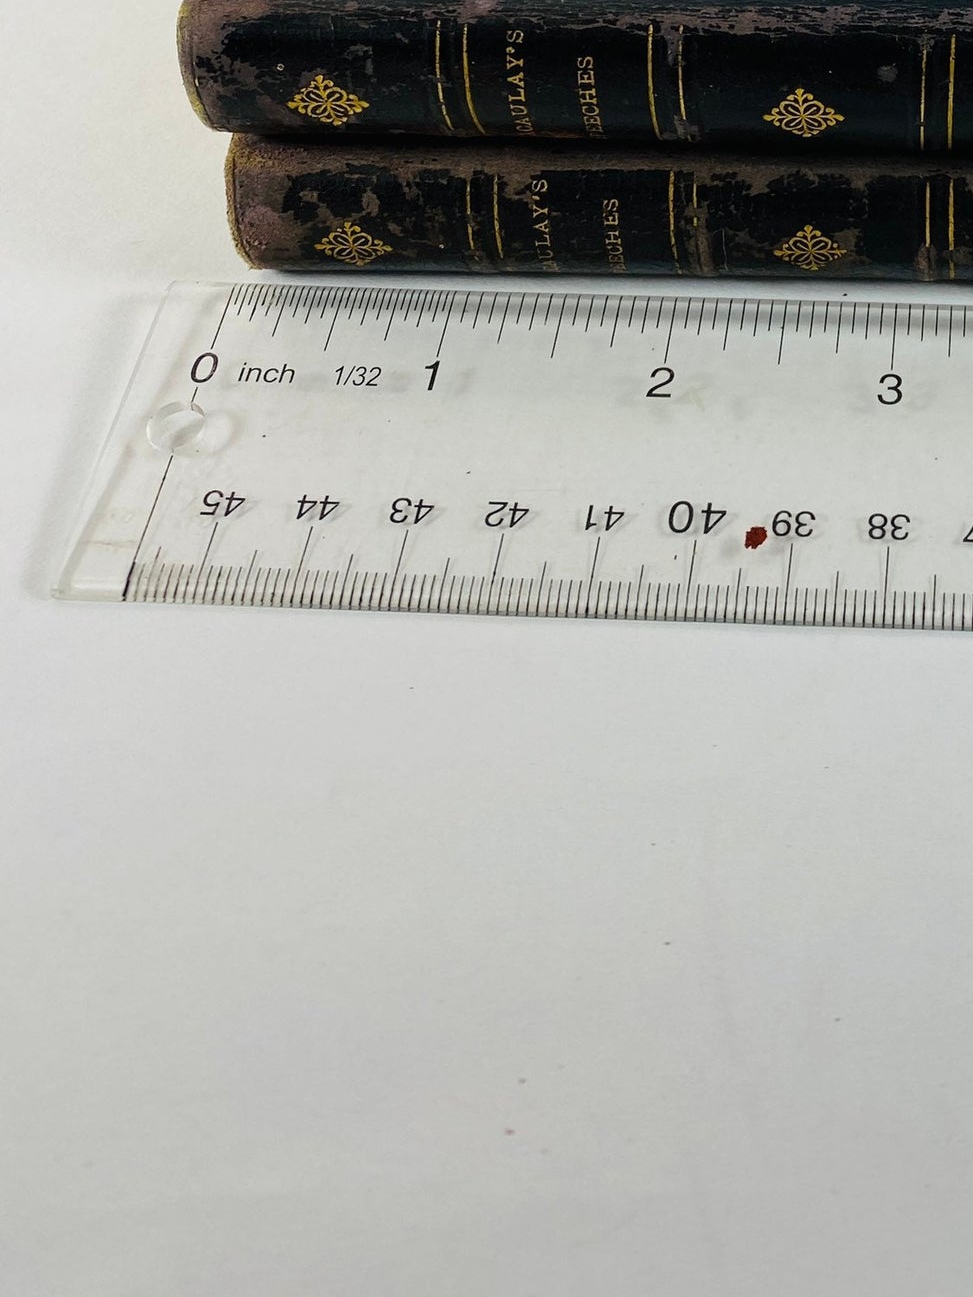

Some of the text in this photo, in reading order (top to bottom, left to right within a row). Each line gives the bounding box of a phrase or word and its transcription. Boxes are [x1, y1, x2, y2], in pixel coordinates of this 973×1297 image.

[506, 29, 536, 136] CAULAY'S
[190, 352, 219, 384] 0
[238, 363, 296, 384] inch
[334, 365, 382, 387] 1/32
[425, 360, 441, 391] 1
[646, 367, 674, 398] 2
[876, 373, 904, 405] 3
[199, 489, 247, 518] 45
[295, 493, 341, 521] 44
[389, 497, 436, 524] 43
[484, 501, 530, 528] 42
[584, 504, 625, 531] 41
[668, 501, 728, 534] 40
[771, 510, 817, 538] 39
[867, 513, 911, 541] 38
